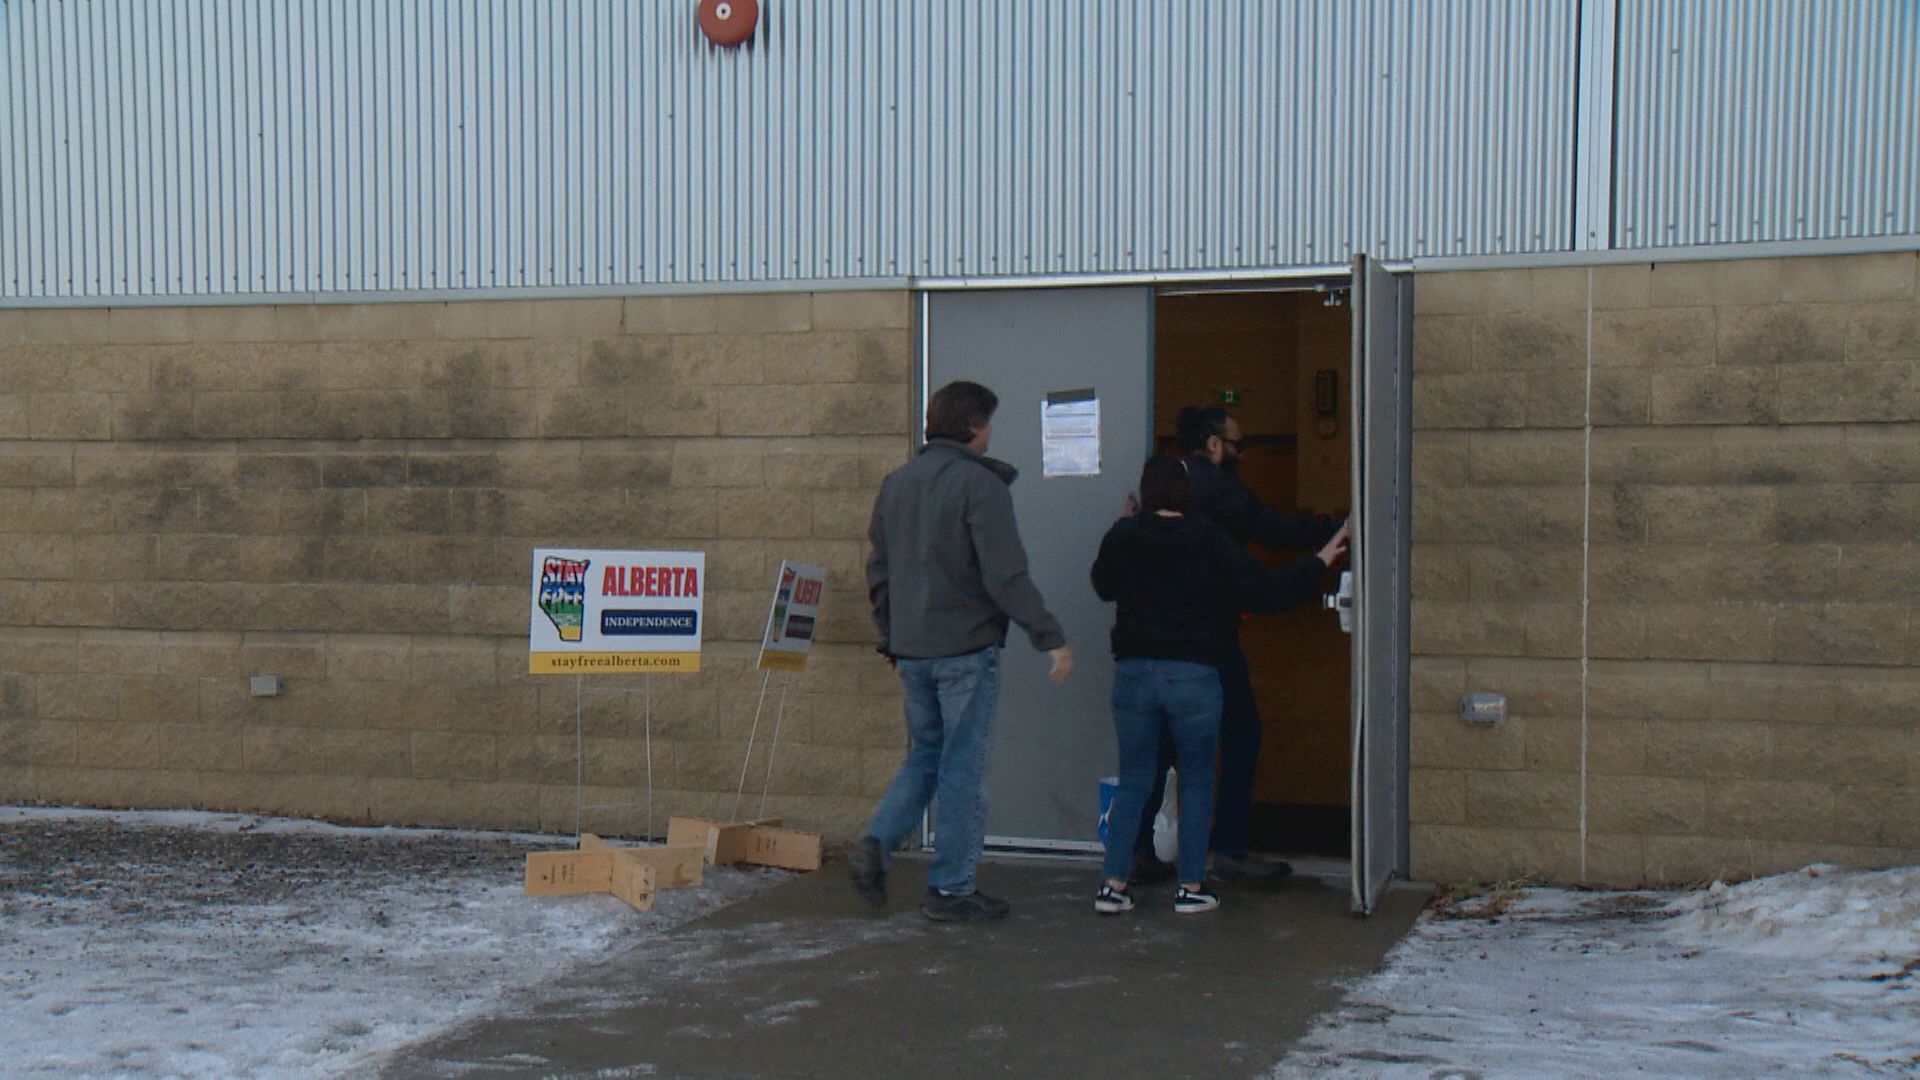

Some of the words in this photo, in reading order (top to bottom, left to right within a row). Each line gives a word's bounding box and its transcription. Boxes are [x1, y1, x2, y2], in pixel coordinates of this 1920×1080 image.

[542, 559, 586, 584] STAY
[602, 566, 698, 597] ALBERTA
[604, 616, 693, 628] INDEPENDENCE
[551, 655, 681, 669] stayfreealberta.com
